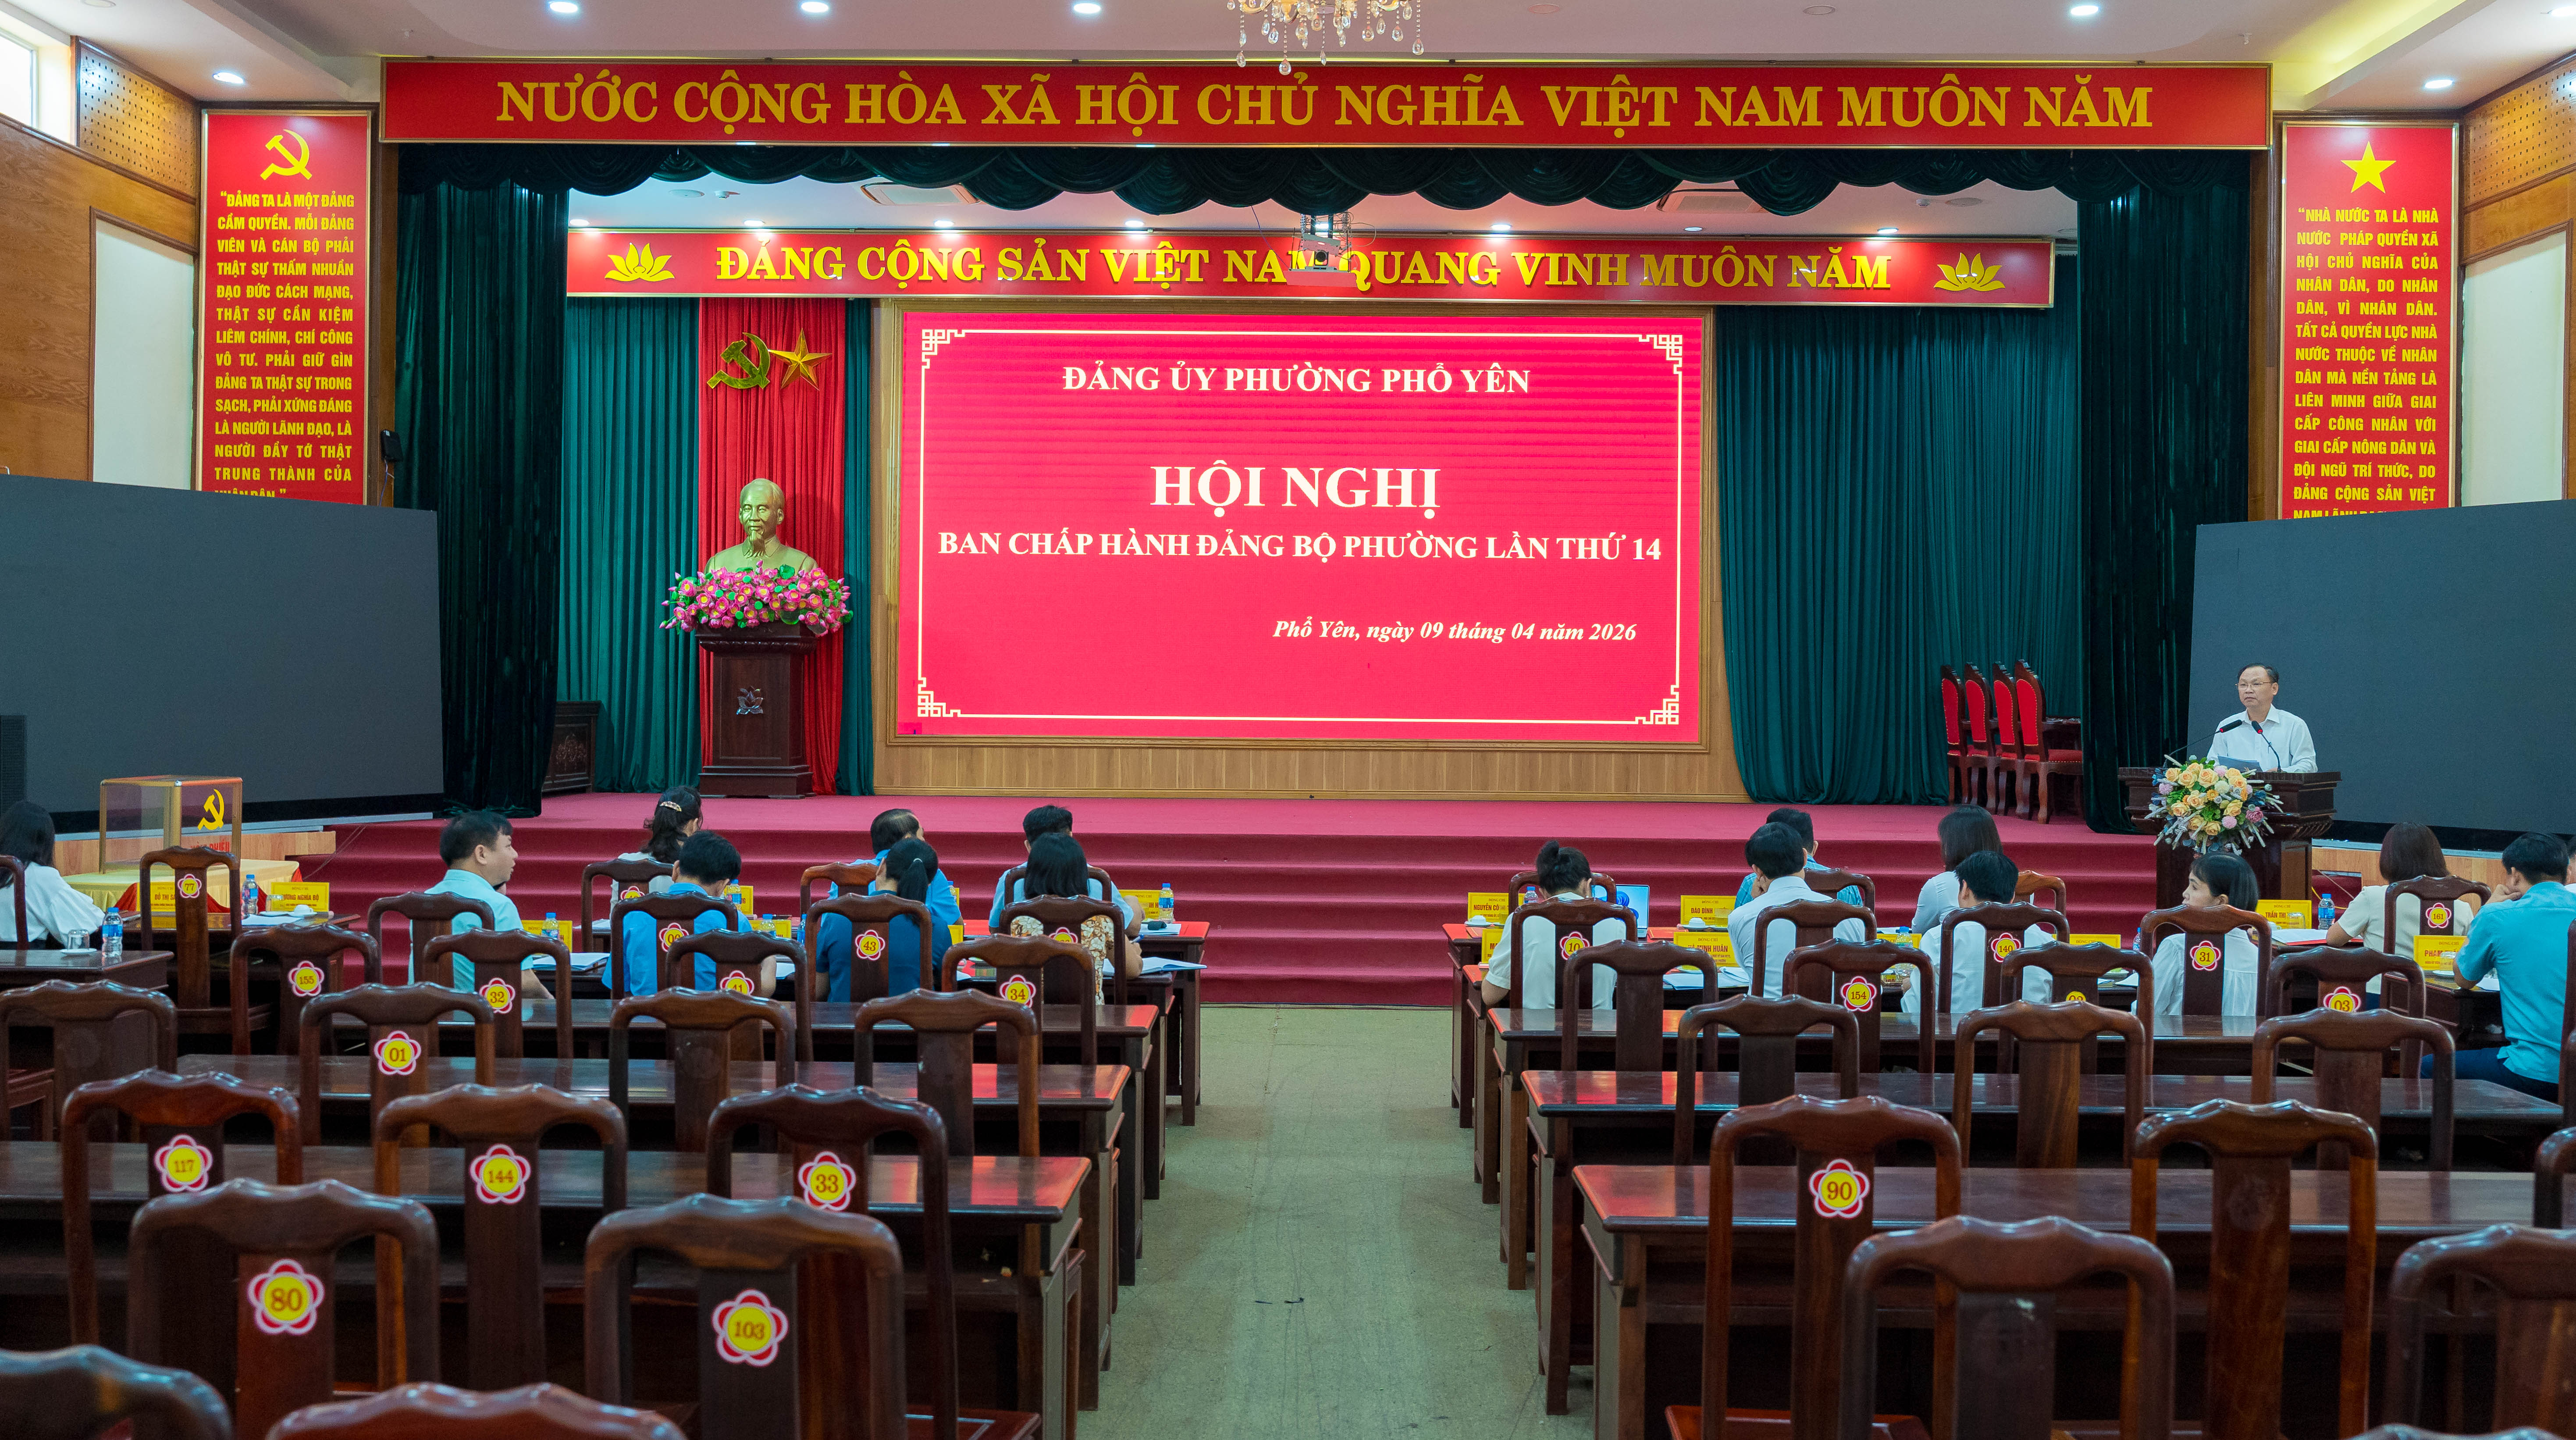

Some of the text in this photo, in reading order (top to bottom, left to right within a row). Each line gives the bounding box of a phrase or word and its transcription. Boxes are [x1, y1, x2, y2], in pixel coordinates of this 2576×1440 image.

[497, 70, 2152, 138] NƯỚC CỘNG HÒA XÃ HỘI CHỦ NGHĨA VIỆT NAM MUÔN NĂM
[221, 189, 355, 210] “ĐẢNG TA LÀ MỘT ĐẢNG
[320, 214, 354, 230] ĐẢNG
[2298, 207, 2439, 223] “NHÀ NƯỚC TA LÀ NHÀ
[217, 236, 354, 256] VIÊN VÀ CÁN BỘ PHẢI
[2297, 230, 2331, 245] NƯỚC
[2340, 230, 2373, 246] PHÁP
[2421, 231, 2439, 246] XÃ
[217, 260, 246, 278] THẬT
[251, 261, 269, 278] SỰ
[272, 258, 306, 275] THẤM
[716, 238, 846, 280] ĐẢNG
[857, 239, 985, 289] CỘNG
[998, 238, 1089, 281] SẢN
[1100, 241, 1209, 289] VIỆT
[1339, 250, 1501, 291] QUANG
[1512, 253, 1630, 285] VINH
[1640, 246, 1777, 287] MUÔN
[1787, 247, 1891, 288] NĂM
[2297, 251, 2438, 271] HỘI CHỦ NGHĨA CỦA
[216, 282, 353, 301] ĐẠO ĐỨC CÁCH MẠNG,
[2296, 275, 2438, 293] NHÂN DÂN, DO NHÂN
[216, 305, 249, 323] THẬT
[257, 307, 276, 324] SỰ
[319, 306, 353, 324] KIỆM
[2296, 299, 2437, 316] DÂN, VÌ NHÂN DÂN.
[216, 328, 353, 345] LIÊM CHÍNH, CHÍ CÔNG
[2295, 321, 2318, 338] TẤT
[2321, 321, 2338, 338] CẢ
[2384, 324, 2408, 341] LỰC
[2411, 323, 2437, 339] NHÀ
[2295, 345, 2330, 361] NƯỚC
[2335, 346, 2375, 364] THUỘC
[2402, 346, 2437, 362] NHÂN
[1063, 360, 1530, 392] ĐẢNG ỦY PHƯỜNG PHỔ YÊN
[1150, 460, 1441, 519] HỘI NGHỊ
[938, 528, 1661, 563] BAN CHẤP HÀNH ĐẢNG BỘ PHƯỜNG LẦN THỨ 14
[1273, 617, 1637, 643] Phổ Yên, ngày 09 tháng 04 năm 2026
[863, 941, 876, 952] 43
[1569, 942, 1580, 952] 10
[2199, 952, 2210, 962] 31
[300, 976, 314, 985] 155
[490, 991, 505, 1003] 32
[1010, 988, 1025, 1000] 34
[1851, 991, 1867, 1000] 154
[2334, 1000, 2350, 1012] 03
[389, 1048, 406, 1062] 01
[174, 1159, 195, 1173] 117
[489, 1169, 514, 1183] 144
[815, 1174, 839, 1193] 33
[1827, 1181, 1852, 1201] 90
[271, 1288, 302, 1312] 80
[735, 1321, 765, 1341] 103
